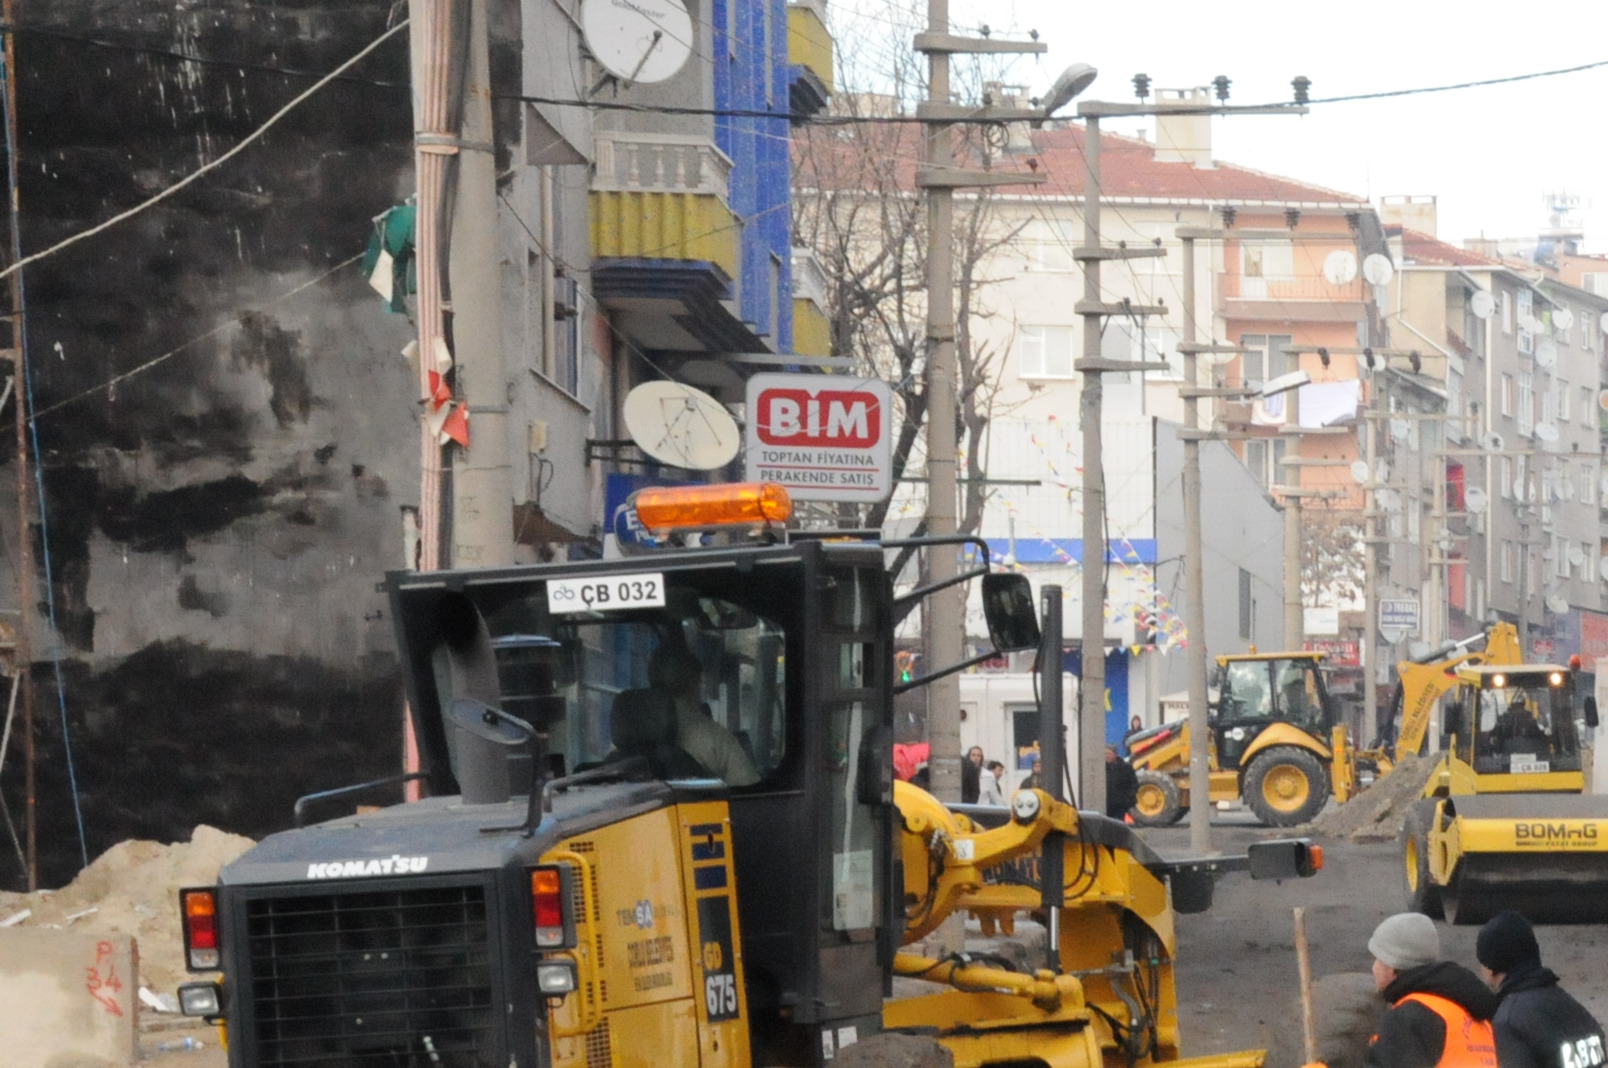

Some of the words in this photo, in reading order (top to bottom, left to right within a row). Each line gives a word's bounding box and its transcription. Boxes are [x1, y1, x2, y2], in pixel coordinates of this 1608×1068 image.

[762, 451, 812, 464] TOPTAN
[817, 451, 874, 466] FİYATINA
[760, 470, 835, 484] PERAKENDE
[840, 473, 874, 486] SATIŞ
[580, 584, 610, 605] ÇB
[618, 581, 658, 601] 032
[306, 854, 428, 879] KOMATSU
[96, 940, 113, 964] P
[706, 974, 736, 1015] 675
